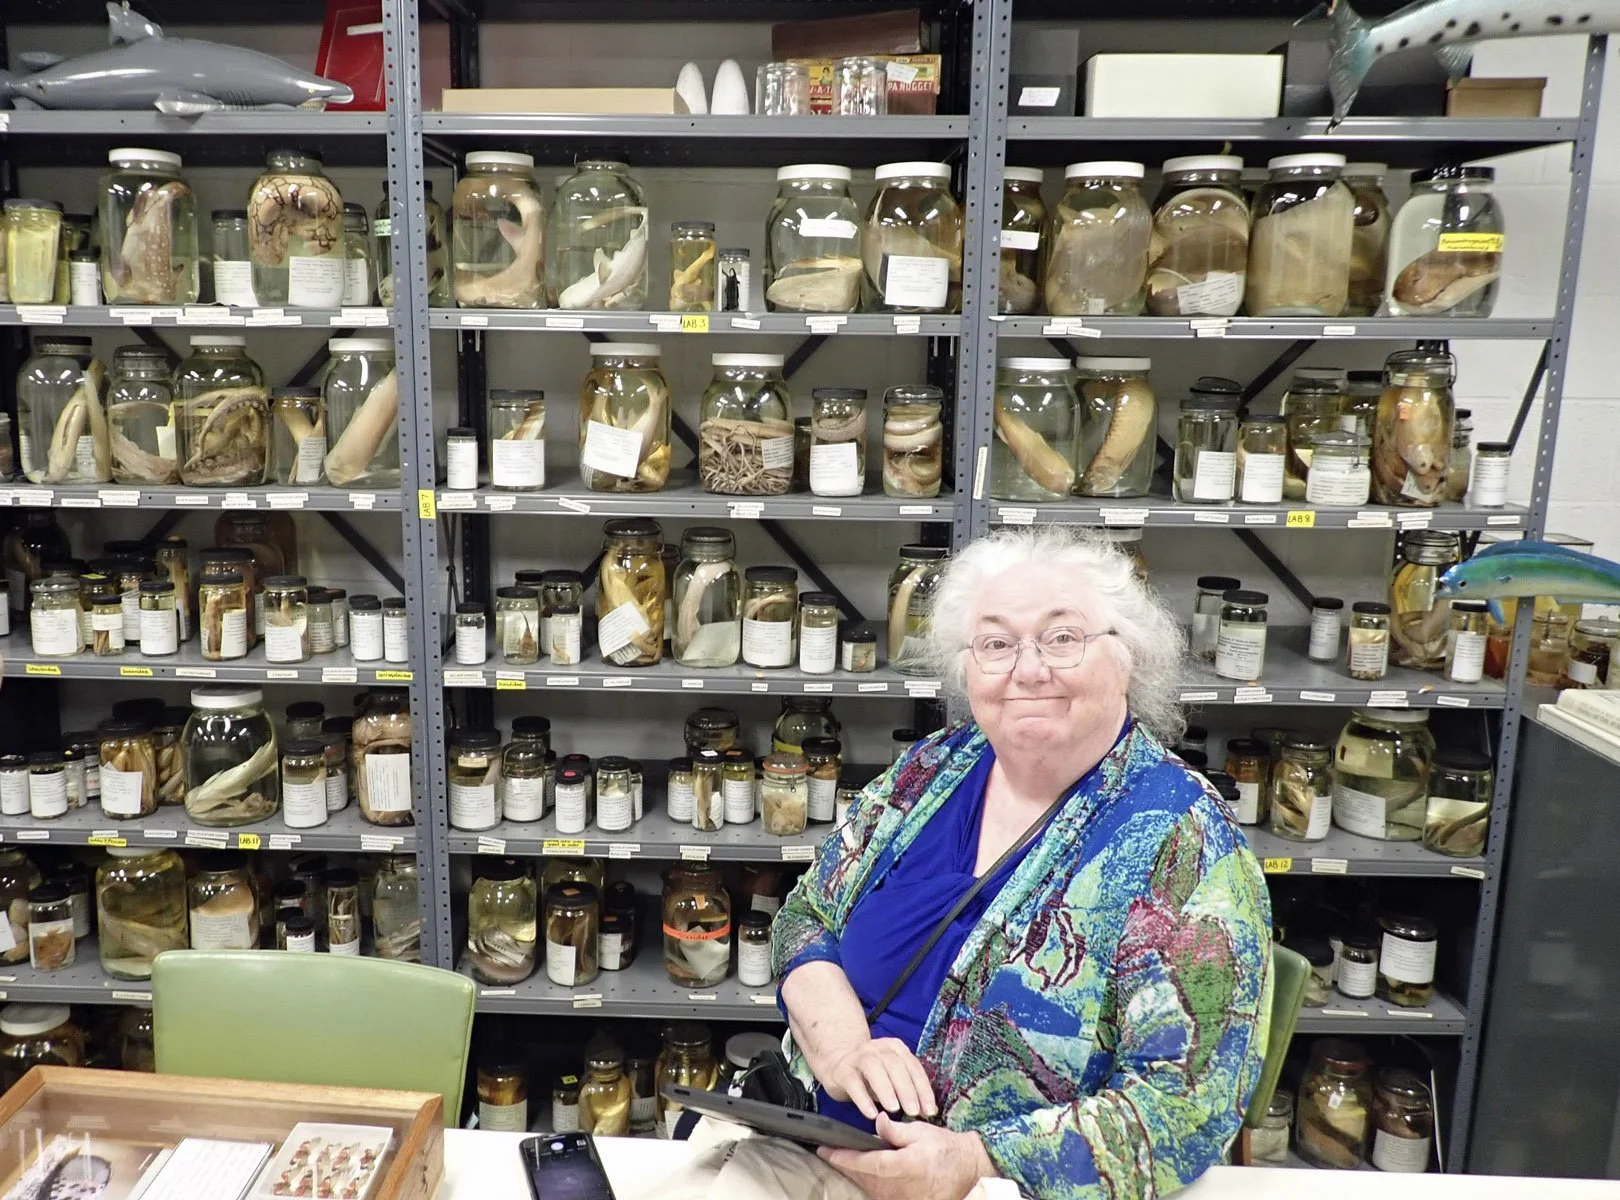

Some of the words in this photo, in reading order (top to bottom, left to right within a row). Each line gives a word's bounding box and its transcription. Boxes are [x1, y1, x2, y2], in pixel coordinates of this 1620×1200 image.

[900, 82, 933, 91] NUGGET
[683, 319, 698, 328] LAB
[699, 319, 706, 328] 3
[422, 502, 431, 517] LAB
[1288, 515, 1303, 523] LAB
[1304, 514, 1311, 523] 8
[240, 837, 252, 845] LAB
[1265, 860, 1278, 869] LAB
[1280, 861, 1289, 869] 12
